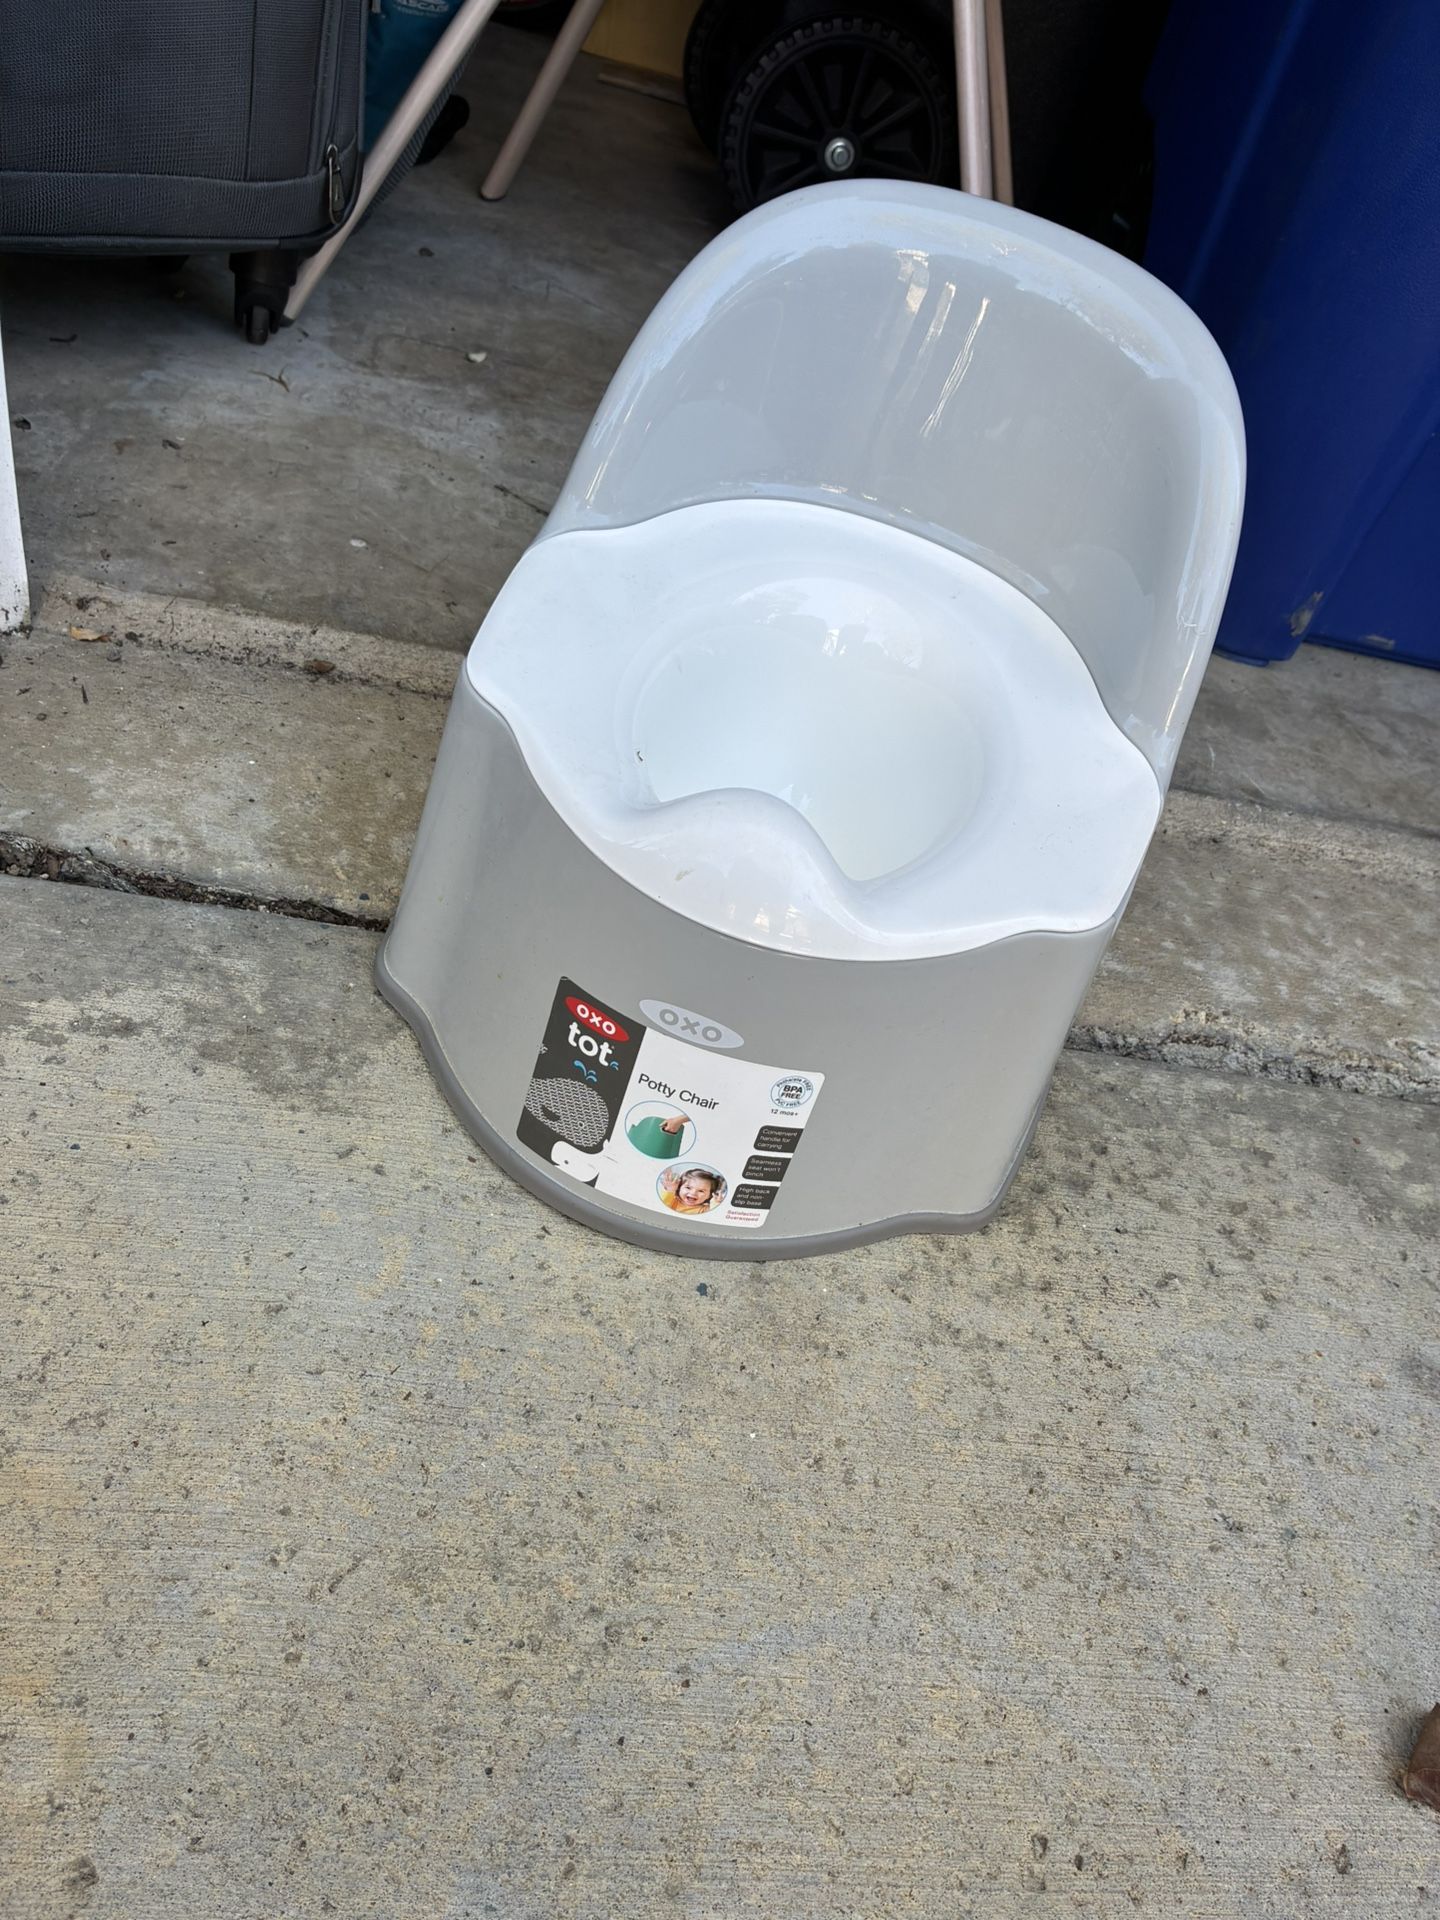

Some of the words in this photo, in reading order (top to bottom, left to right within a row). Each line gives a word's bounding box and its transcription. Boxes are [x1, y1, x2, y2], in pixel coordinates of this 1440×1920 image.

[576, 1004, 616, 1035] OXO
[659, 1008, 722, 1042] OXO
[568, 1021, 613, 1067] tot
[638, 1073, 676, 1098] Potty
[679, 1089, 720, 1111] Chair
[783, 1084, 803, 1094] BPA
[780, 1092, 801, 1100] FREE
[762, 1128, 798, 1137] Convenient
[760, 1135, 781, 1143] handle
[757, 1142, 783, 1150] carrying
[750, 1158, 782, 1166] Seamless
